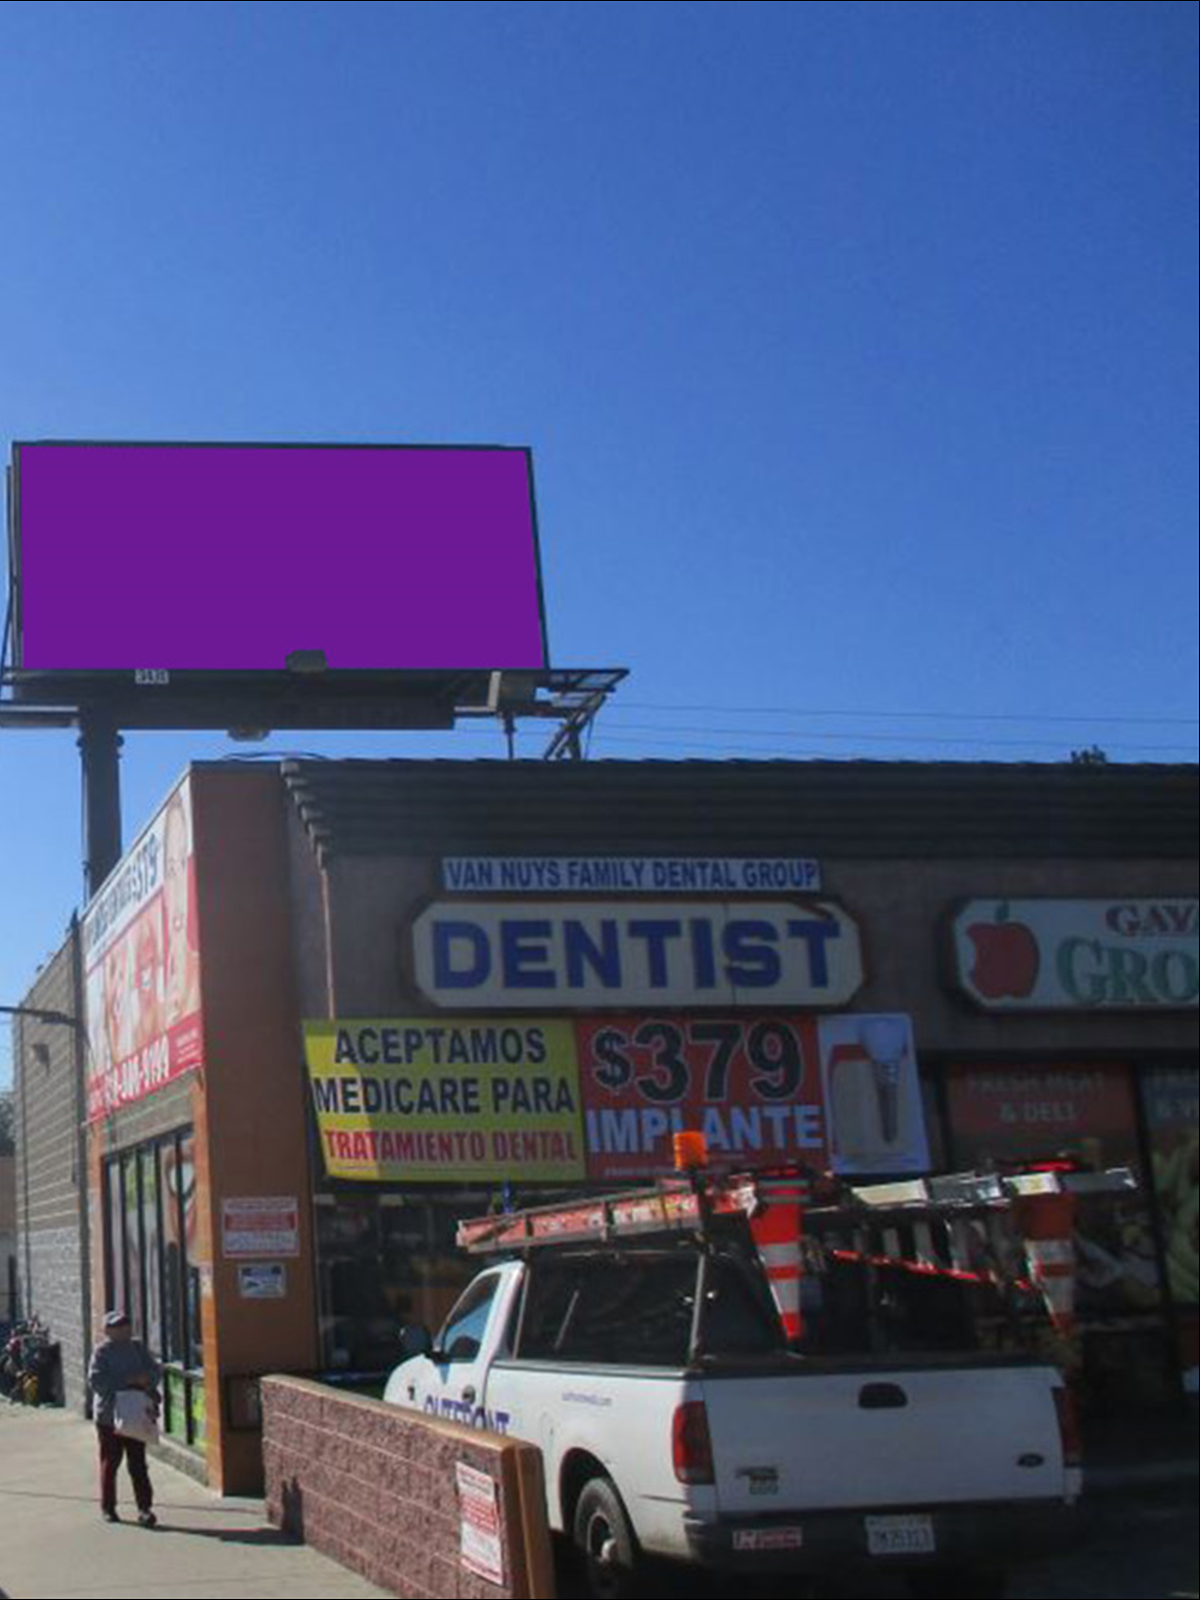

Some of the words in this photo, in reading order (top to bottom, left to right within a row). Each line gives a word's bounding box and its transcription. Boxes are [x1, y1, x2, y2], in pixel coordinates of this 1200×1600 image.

[447, 860, 492, 889] VAN
[500, 860, 561, 889] NUYS
[567, 860, 646, 889] FAMILY
[652, 860, 736, 888] DENTAL
[742, 859, 817, 887] GROUP
[431, 917, 841, 990] DENTIST
[334, 1027, 546, 1064] ACEPTAMOS
[593, 1018, 801, 1103] $379
[313, 1077, 481, 1115] MEDICARE
[491, 1077, 576, 1114] PARA
[324, 1129, 486, 1161] TRATAMIENTO
[493, 1130, 577, 1161] DENTAL
